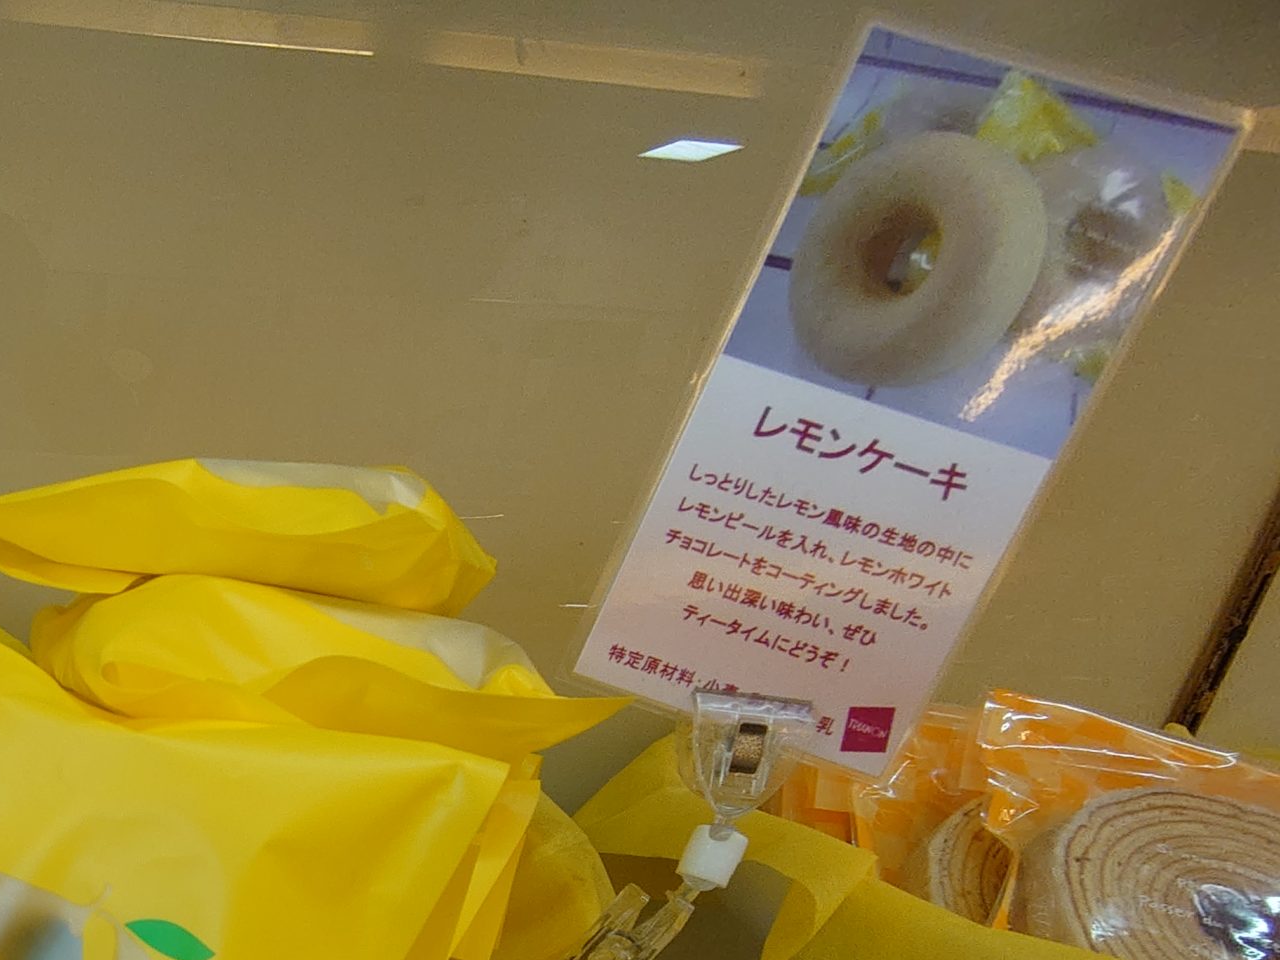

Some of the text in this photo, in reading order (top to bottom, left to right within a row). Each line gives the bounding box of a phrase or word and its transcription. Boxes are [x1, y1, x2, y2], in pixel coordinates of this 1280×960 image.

[753, 406, 967, 500] レモンケーキ
[677, 498, 952, 598] レモンピールを入れ、レモンホワイト
[689, 464, 973, 570] しっとりしたレモン風味の生地の中に
[665, 527, 929, 631] チョコレートをコーティングしました。
[688, 571, 876, 645] 思い出深い味わい、ぜひ
